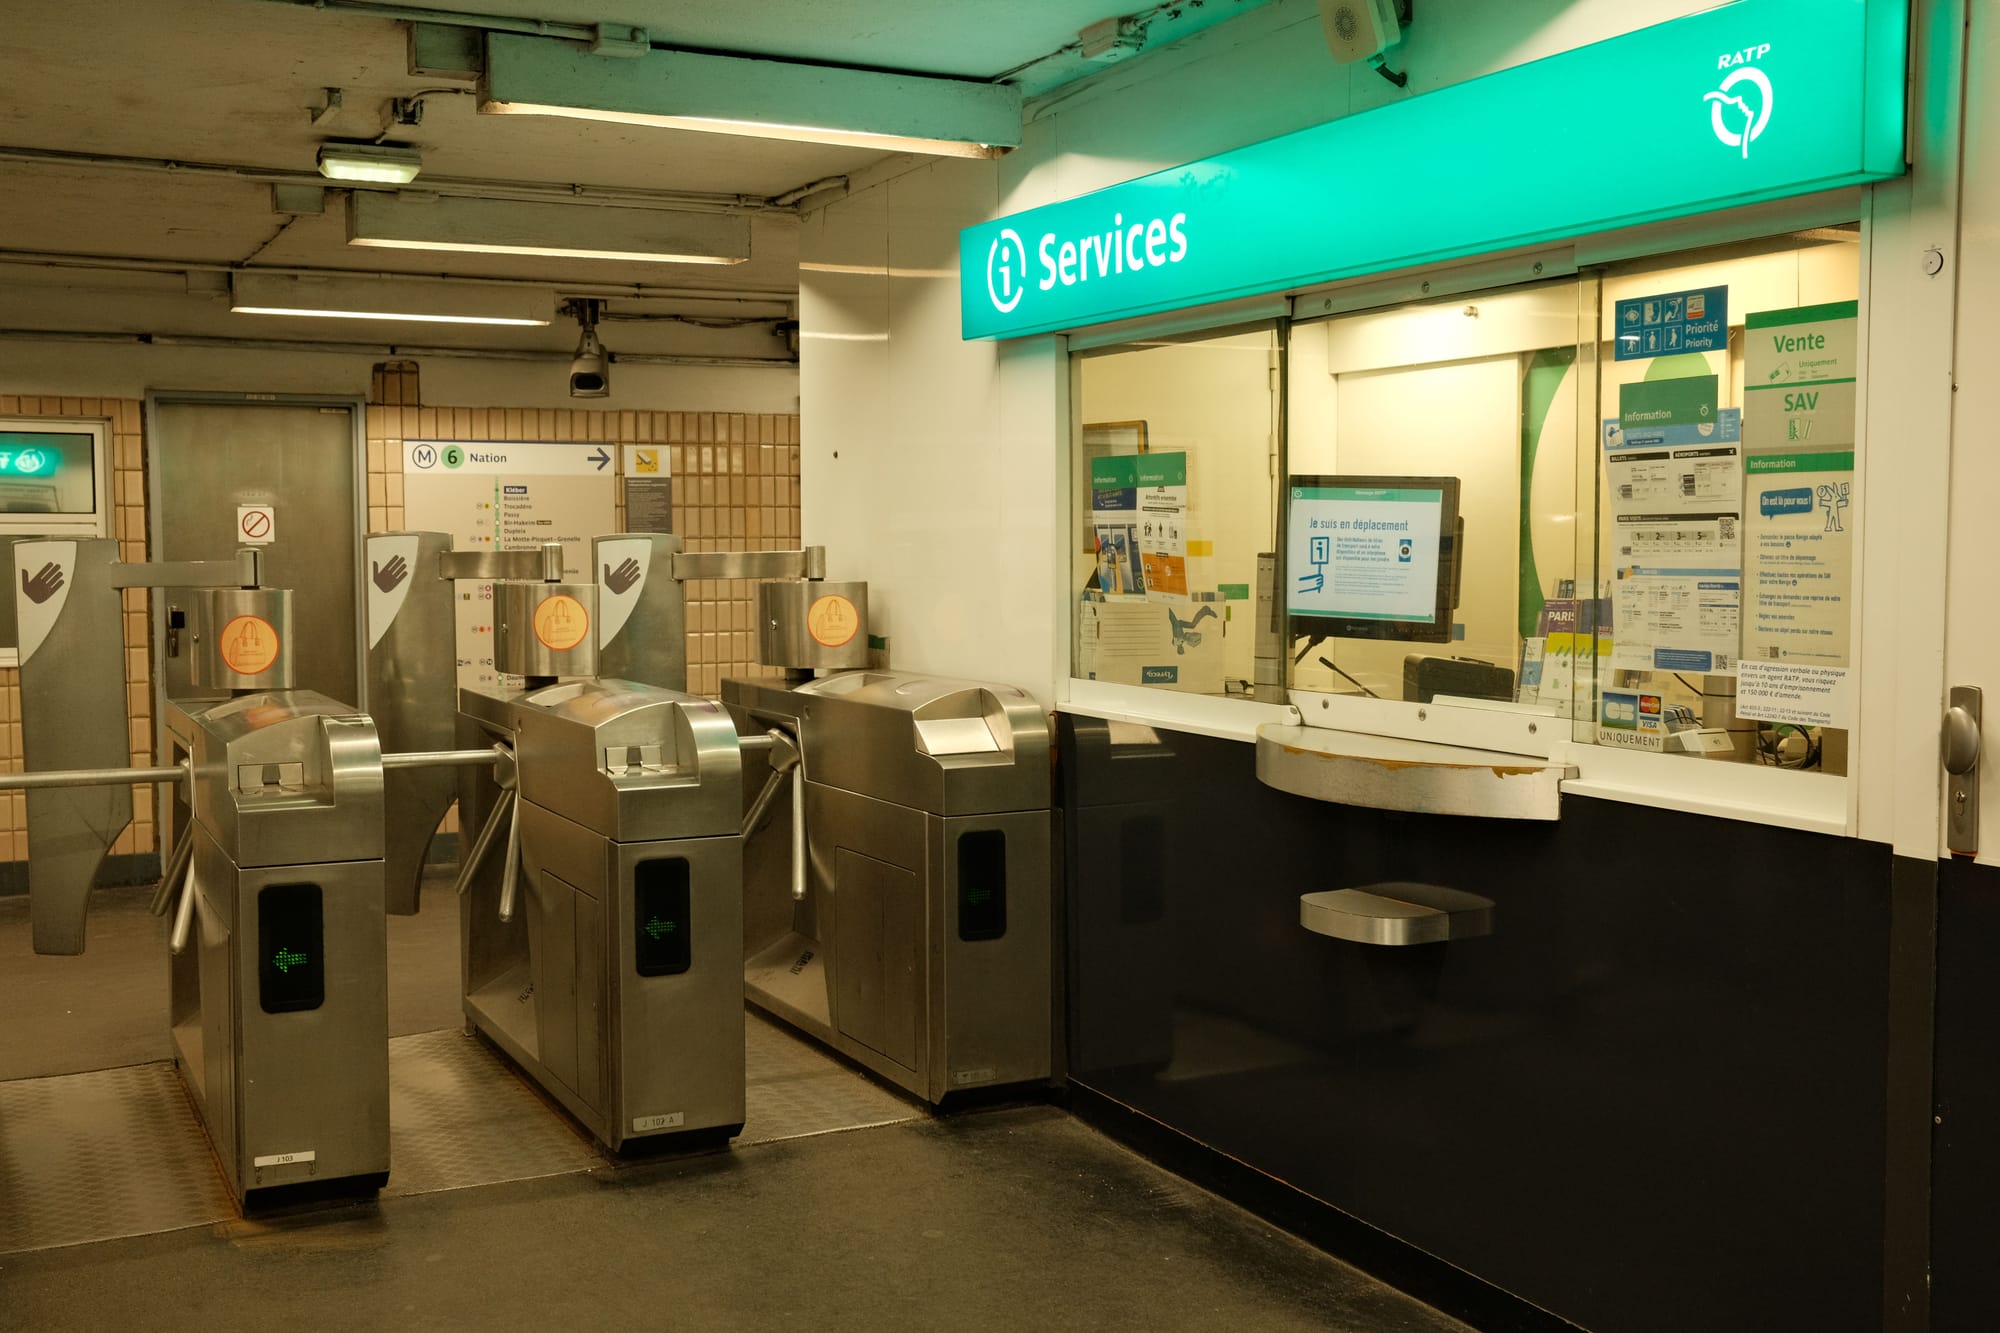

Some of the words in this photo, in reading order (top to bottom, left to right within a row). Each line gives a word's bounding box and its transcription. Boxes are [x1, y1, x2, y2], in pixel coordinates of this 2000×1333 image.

[1718, 43, 1771, 70] RATP
[1039, 212, 1188, 291] Services
[1686, 320, 1719, 335] Priorité
[1686, 337, 1712, 348] Priority
[1773, 333, 1825, 353] Vente
[1798, 358, 1837, 368] Uniquement
[1784, 391, 1819, 412] SAV
[1624, 409, 1672, 422] Information
[447, 450, 458, 465] 6
[470, 453, 507, 463] Nation
[1750, 459, 1796, 469] Information
[1784, 497, 1796, 507] pour
[1796, 497, 1808, 505] vous
[1309, 517, 1318, 529] Je
[1320, 519, 1337, 528] suis
[1340, 521, 1350, 529] en
[1353, 518, 1408, 532] déplacement
[1790, 666, 1810, 674] verbale
[1820, 668, 1846, 678] physique
[1767, 674, 1782, 682] agent
[1816, 678, 1836, 686] risquez
[1779, 683, 1831, 694] d'emprisonnement
[1600, 731, 1661, 748] UNIQUEMENT
